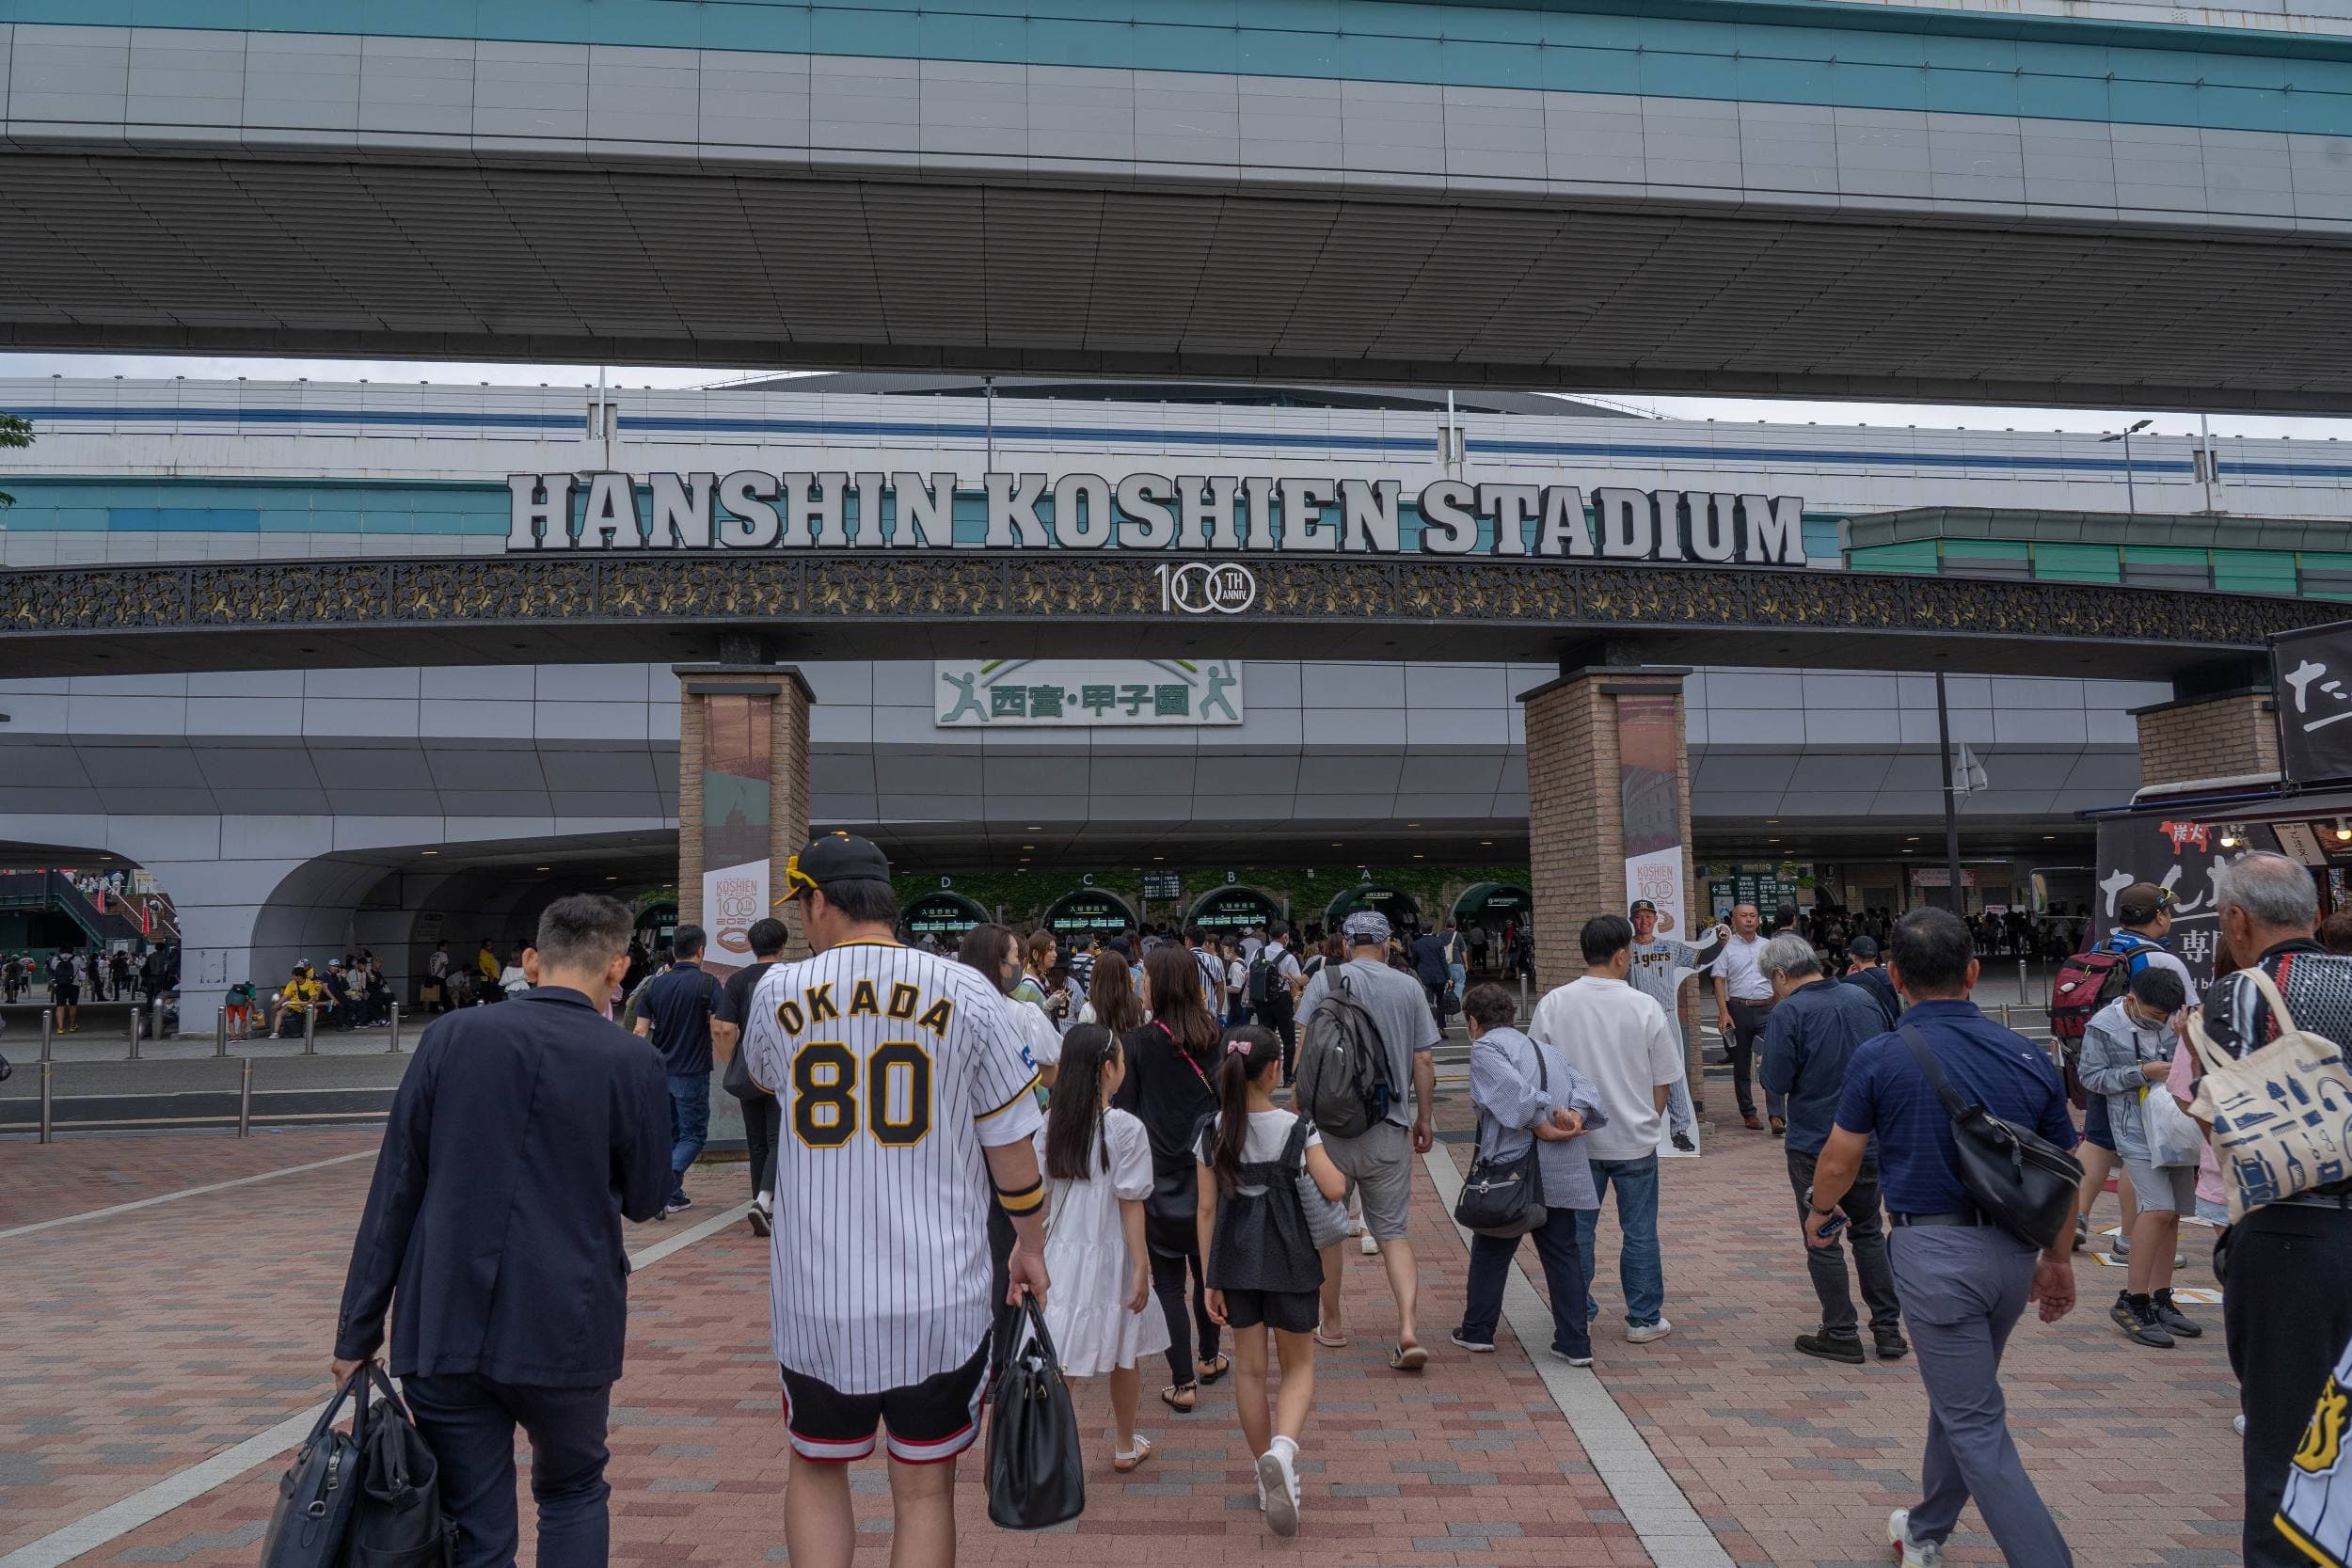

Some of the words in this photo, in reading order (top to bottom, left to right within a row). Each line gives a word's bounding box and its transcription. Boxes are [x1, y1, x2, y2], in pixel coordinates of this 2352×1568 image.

[506, 470, 956, 551] HANSHIN
[984, 472, 1401, 553] KOSHIEN
[1418, 481, 1806, 566] STADIUM
[1154, 562, 1256, 614] 100
[1225, 572, 1243, 590] TH
[990, 685, 1189, 717] 西宮・甲子園
[1083, 873, 1093, 885] C
[1227, 871, 1236, 883] B
[1361, 869, 1372, 879] A
[1637, 865, 1673, 878] KOSHIEN
[716, 880, 757, 893] KOSHIEN
[941, 876, 951, 888] D
[1638, 880, 1674, 899] 100
[716, 896, 757, 918] 100
[1631, 952, 1671, 968] igers
[774, 979, 954, 1038] OKADA
[791, 1040, 932, 1148] 80
